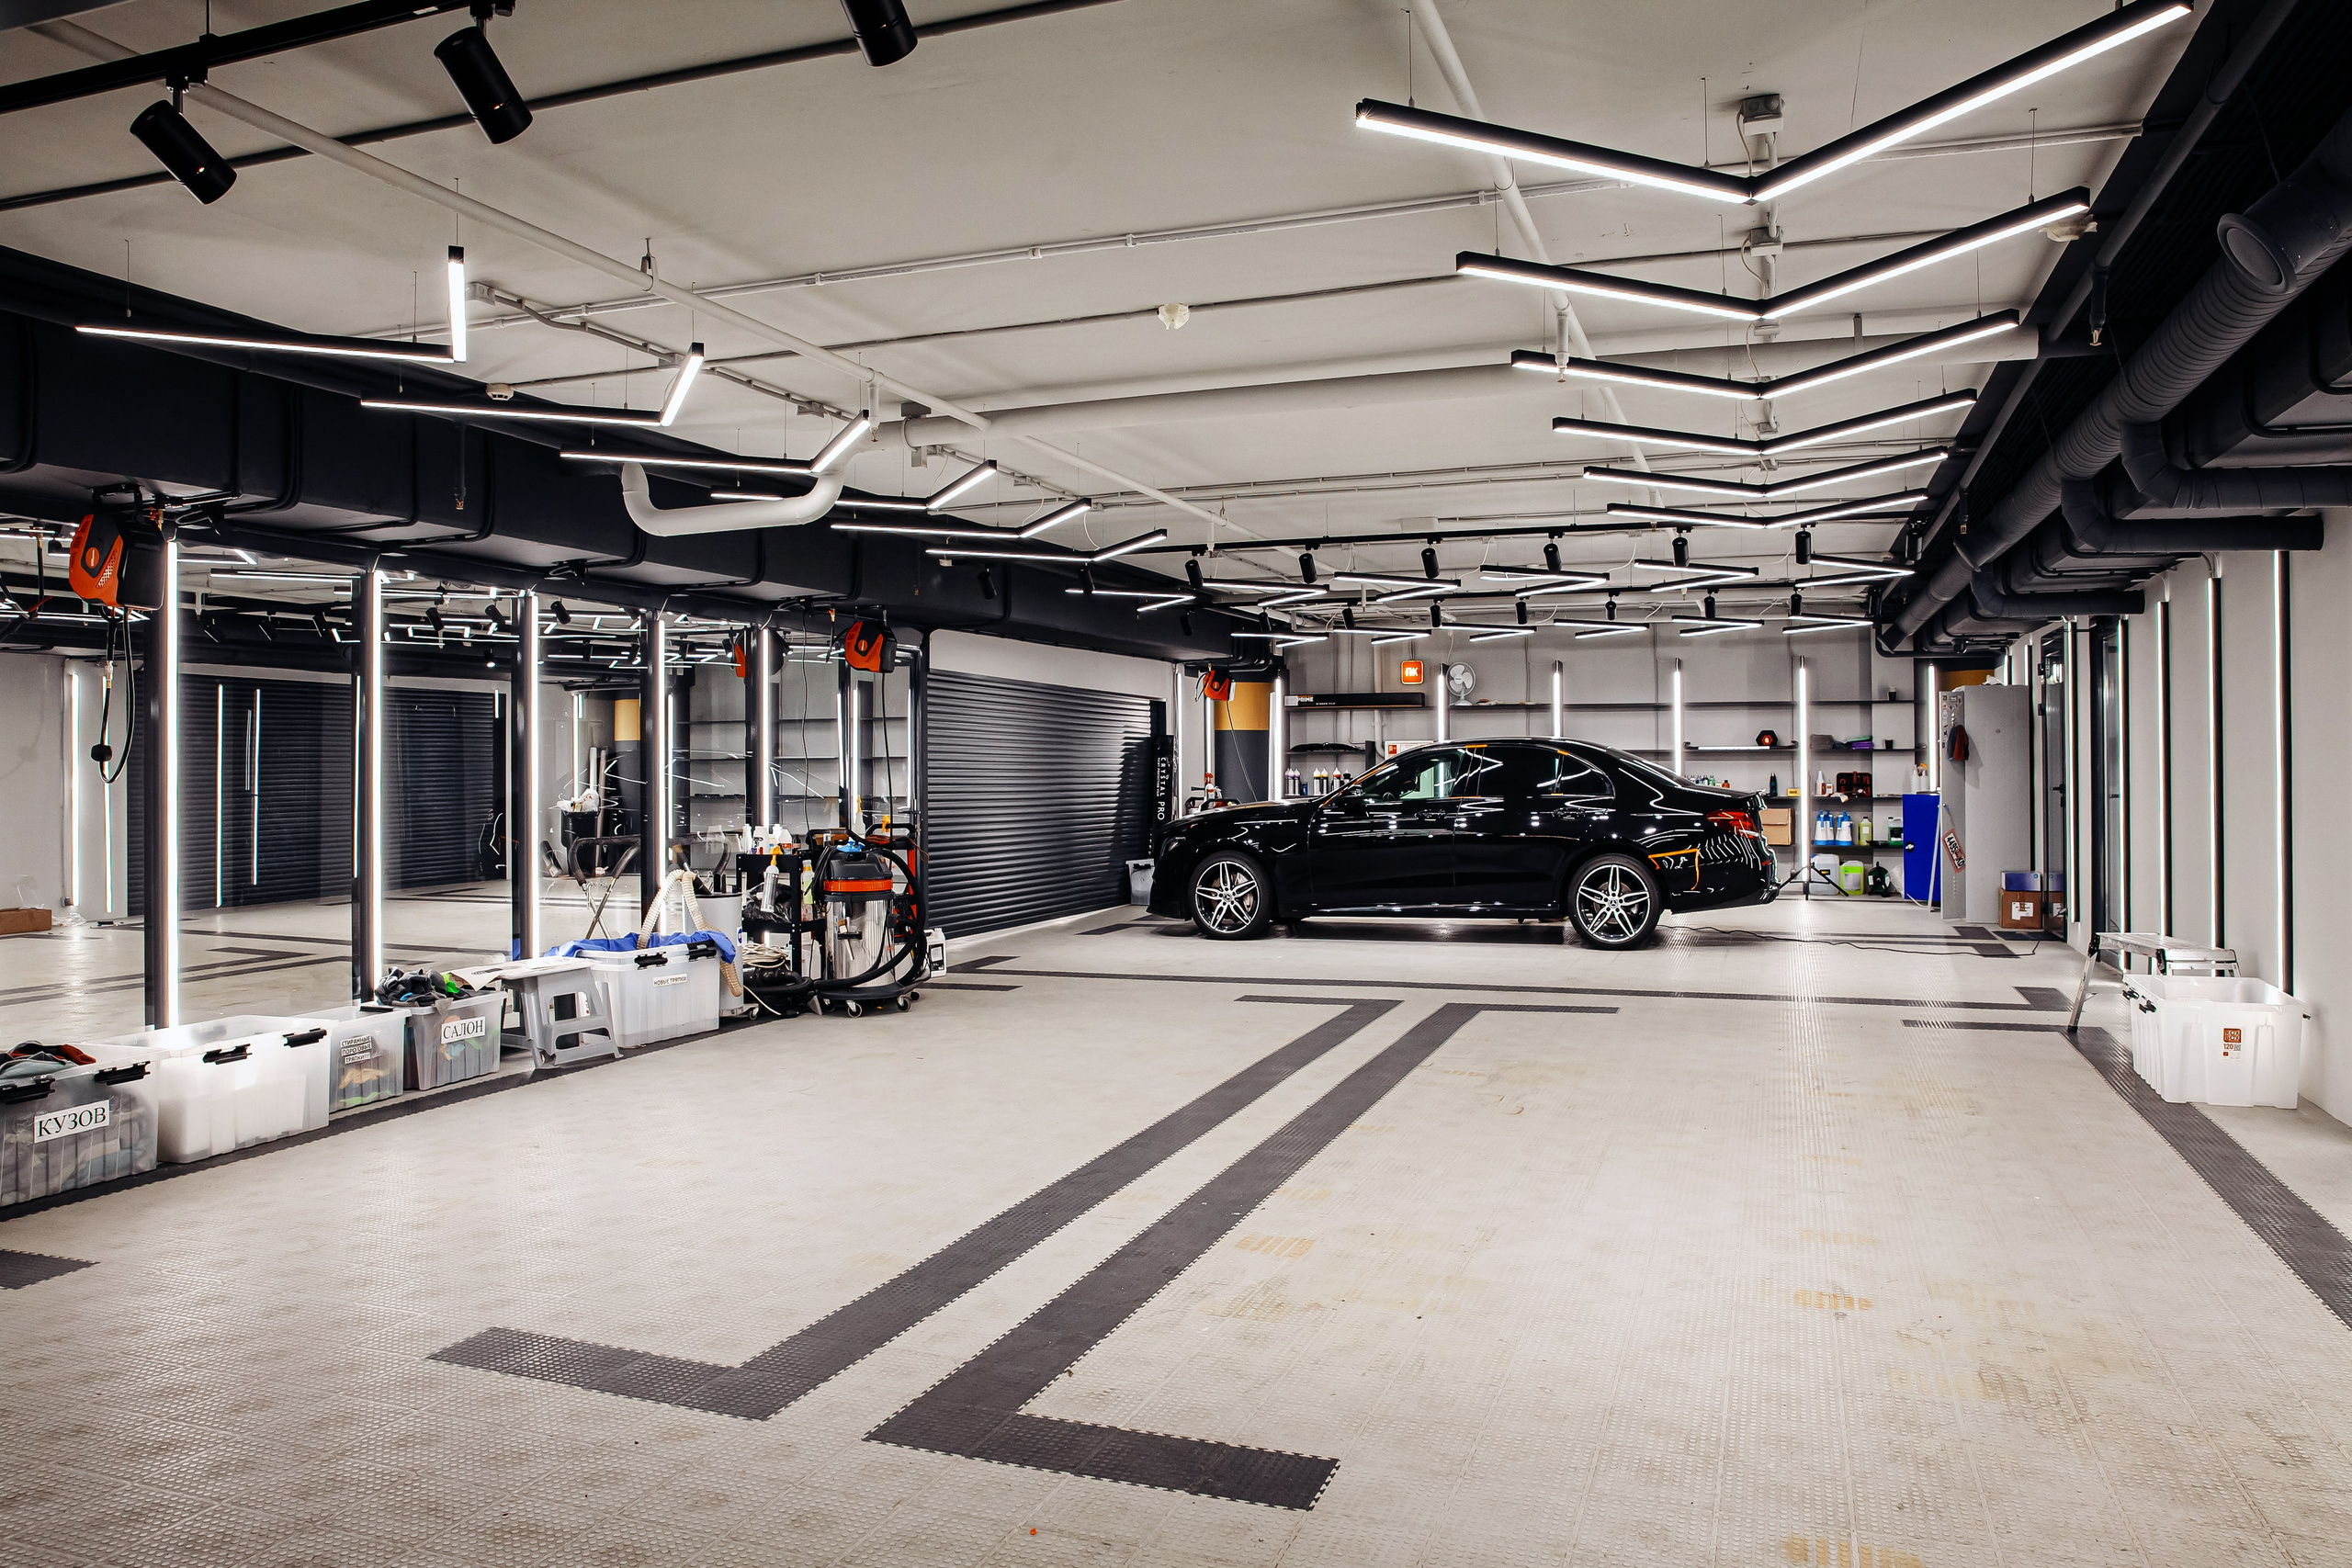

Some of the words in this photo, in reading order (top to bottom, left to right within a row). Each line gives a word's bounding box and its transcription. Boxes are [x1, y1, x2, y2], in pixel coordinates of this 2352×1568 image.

[1405, 667, 1419, 677] ПК
[1157, 801, 1165, 820] PRO
[443, 1020, 483, 1039] САЛОН
[341, 1035, 370, 1046] СТИРАННЫЕ
[342, 1043, 371, 1055] ПОРООВЫЕ
[38, 1107, 107, 1137] КУЗОВ
